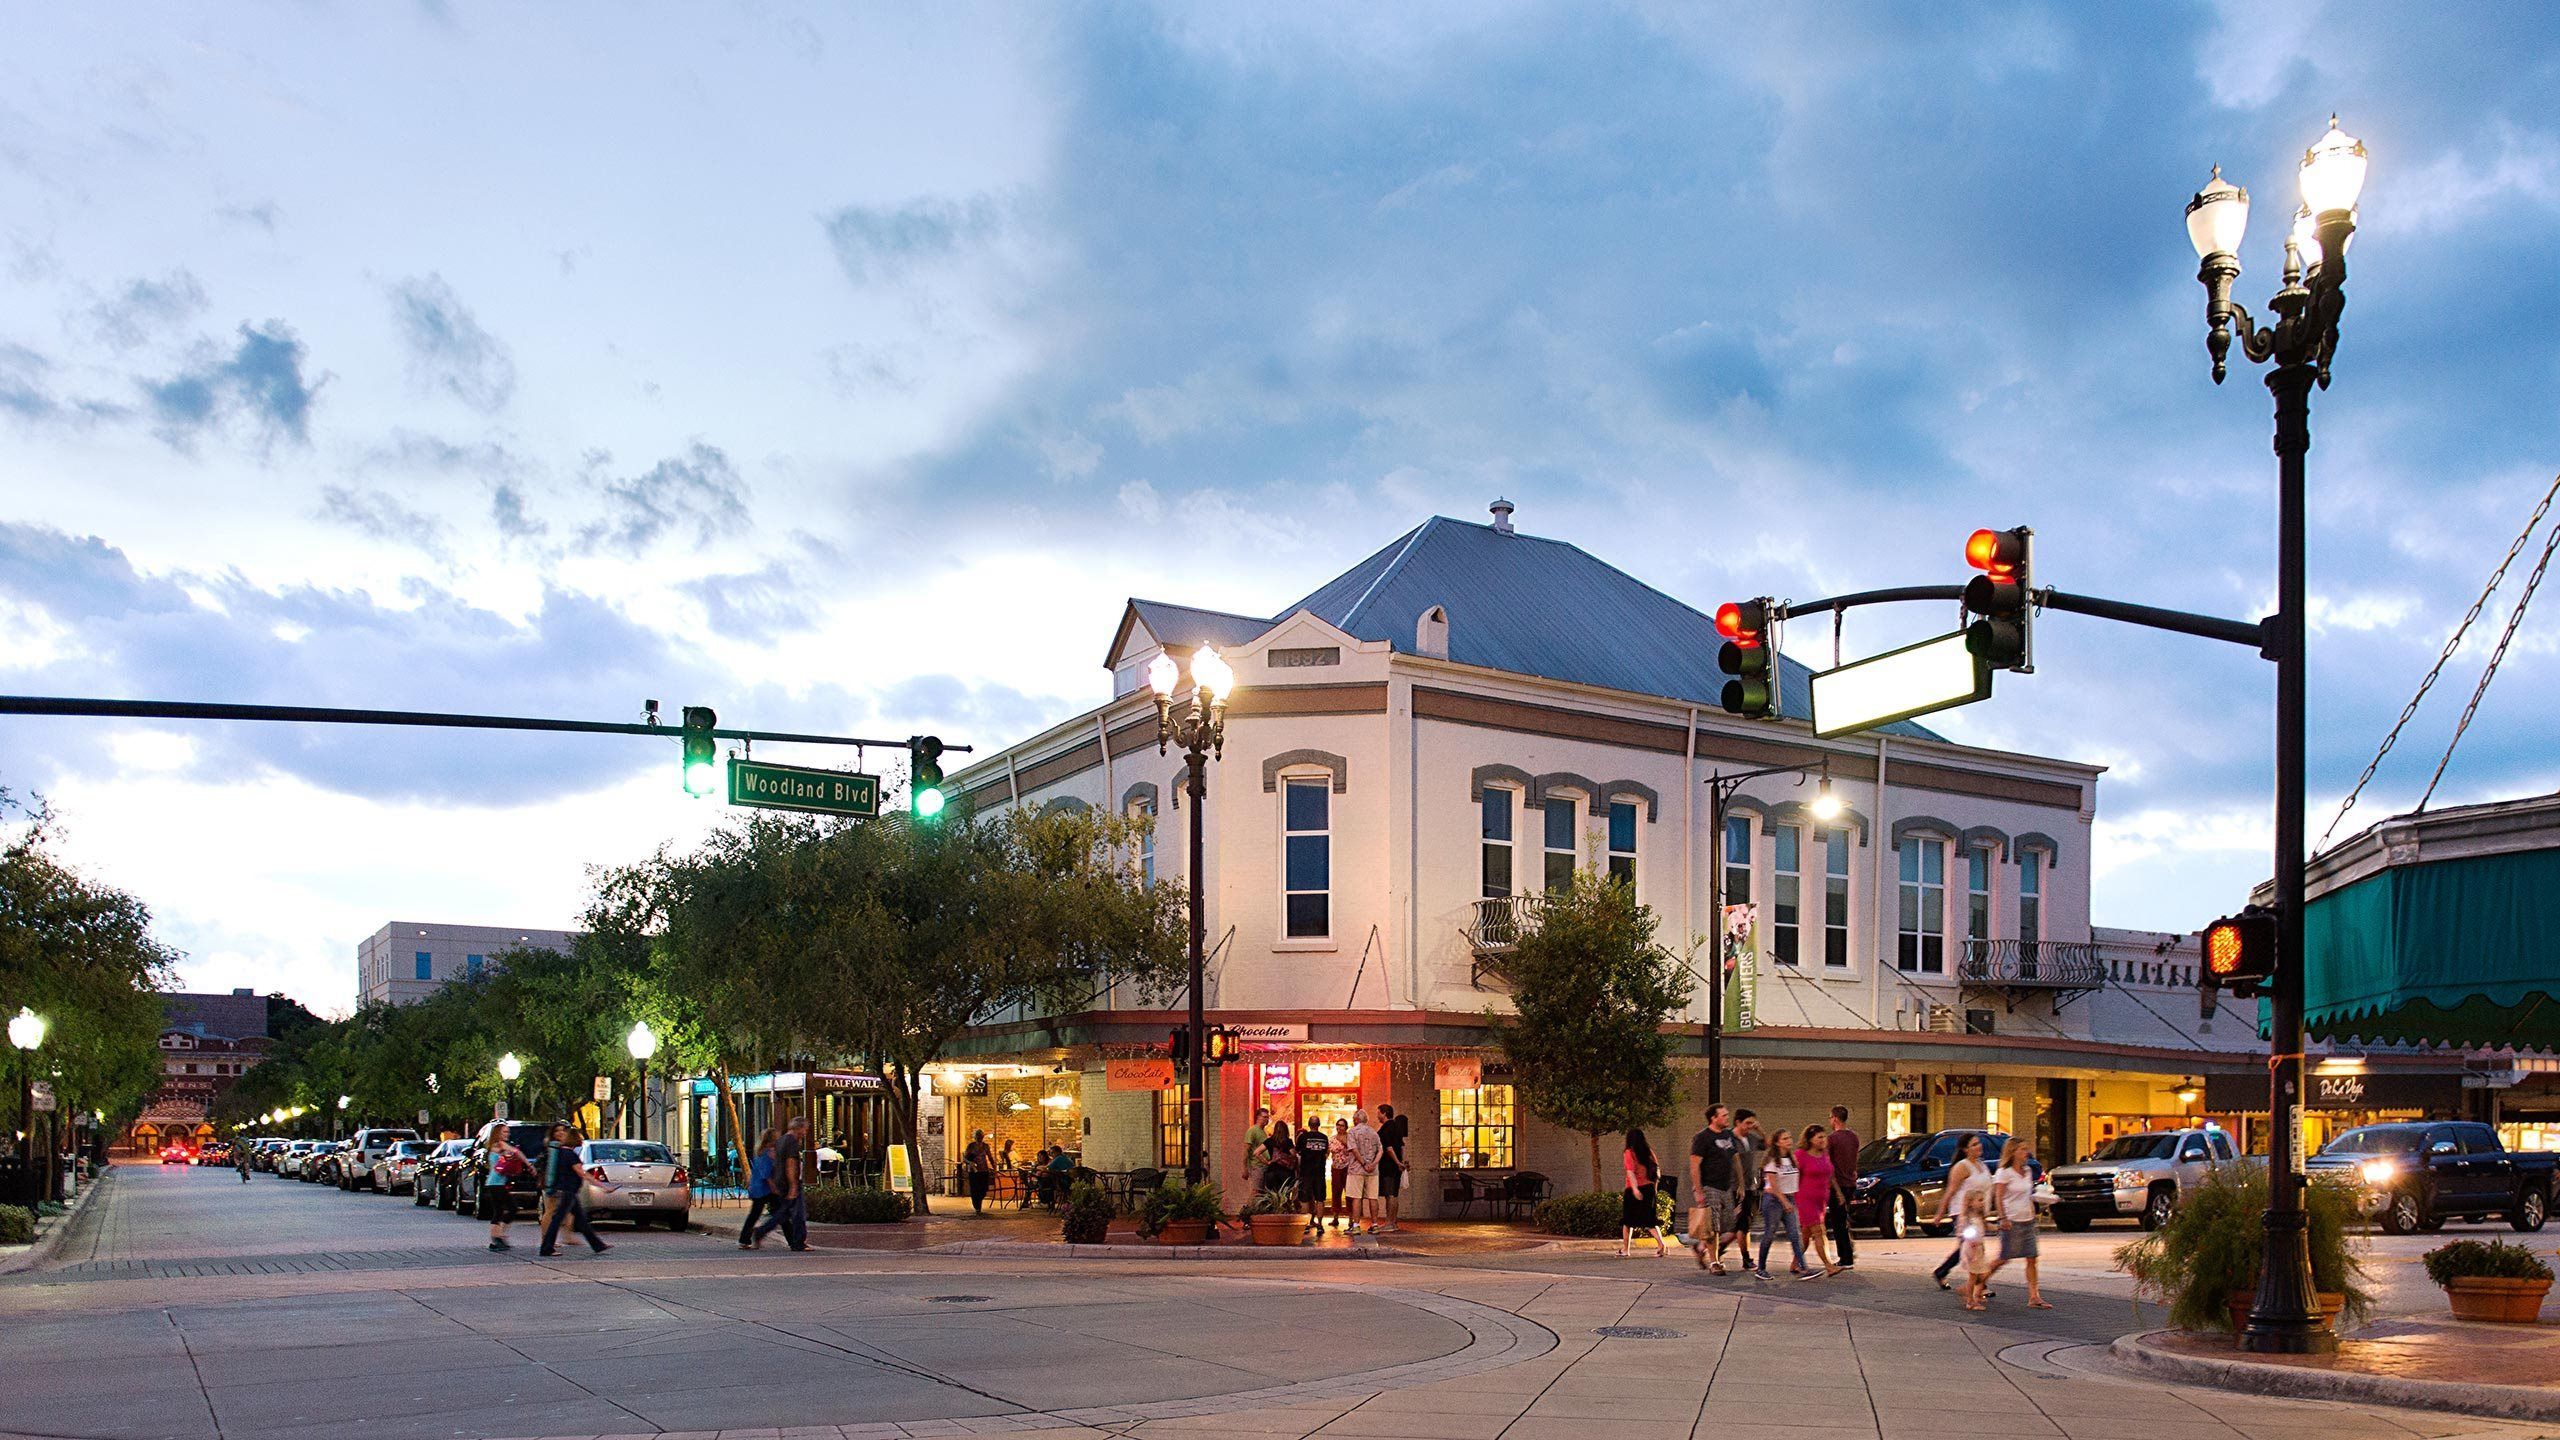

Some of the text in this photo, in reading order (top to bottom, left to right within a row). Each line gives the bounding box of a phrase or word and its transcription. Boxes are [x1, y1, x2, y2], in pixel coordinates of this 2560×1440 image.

[745, 773, 868, 803] Woodland Blvd
[1740, 951, 1754, 1028] GO HATTERS
[1229, 1024, 1290, 1037] Chocolate
[1114, 1067, 1164, 1079] Chocolate
[1903, 1082, 1915, 1091] ICE
[1951, 1083, 1983, 1095] Ice Cream
[1897, 1091, 1921, 1100] CREAM
